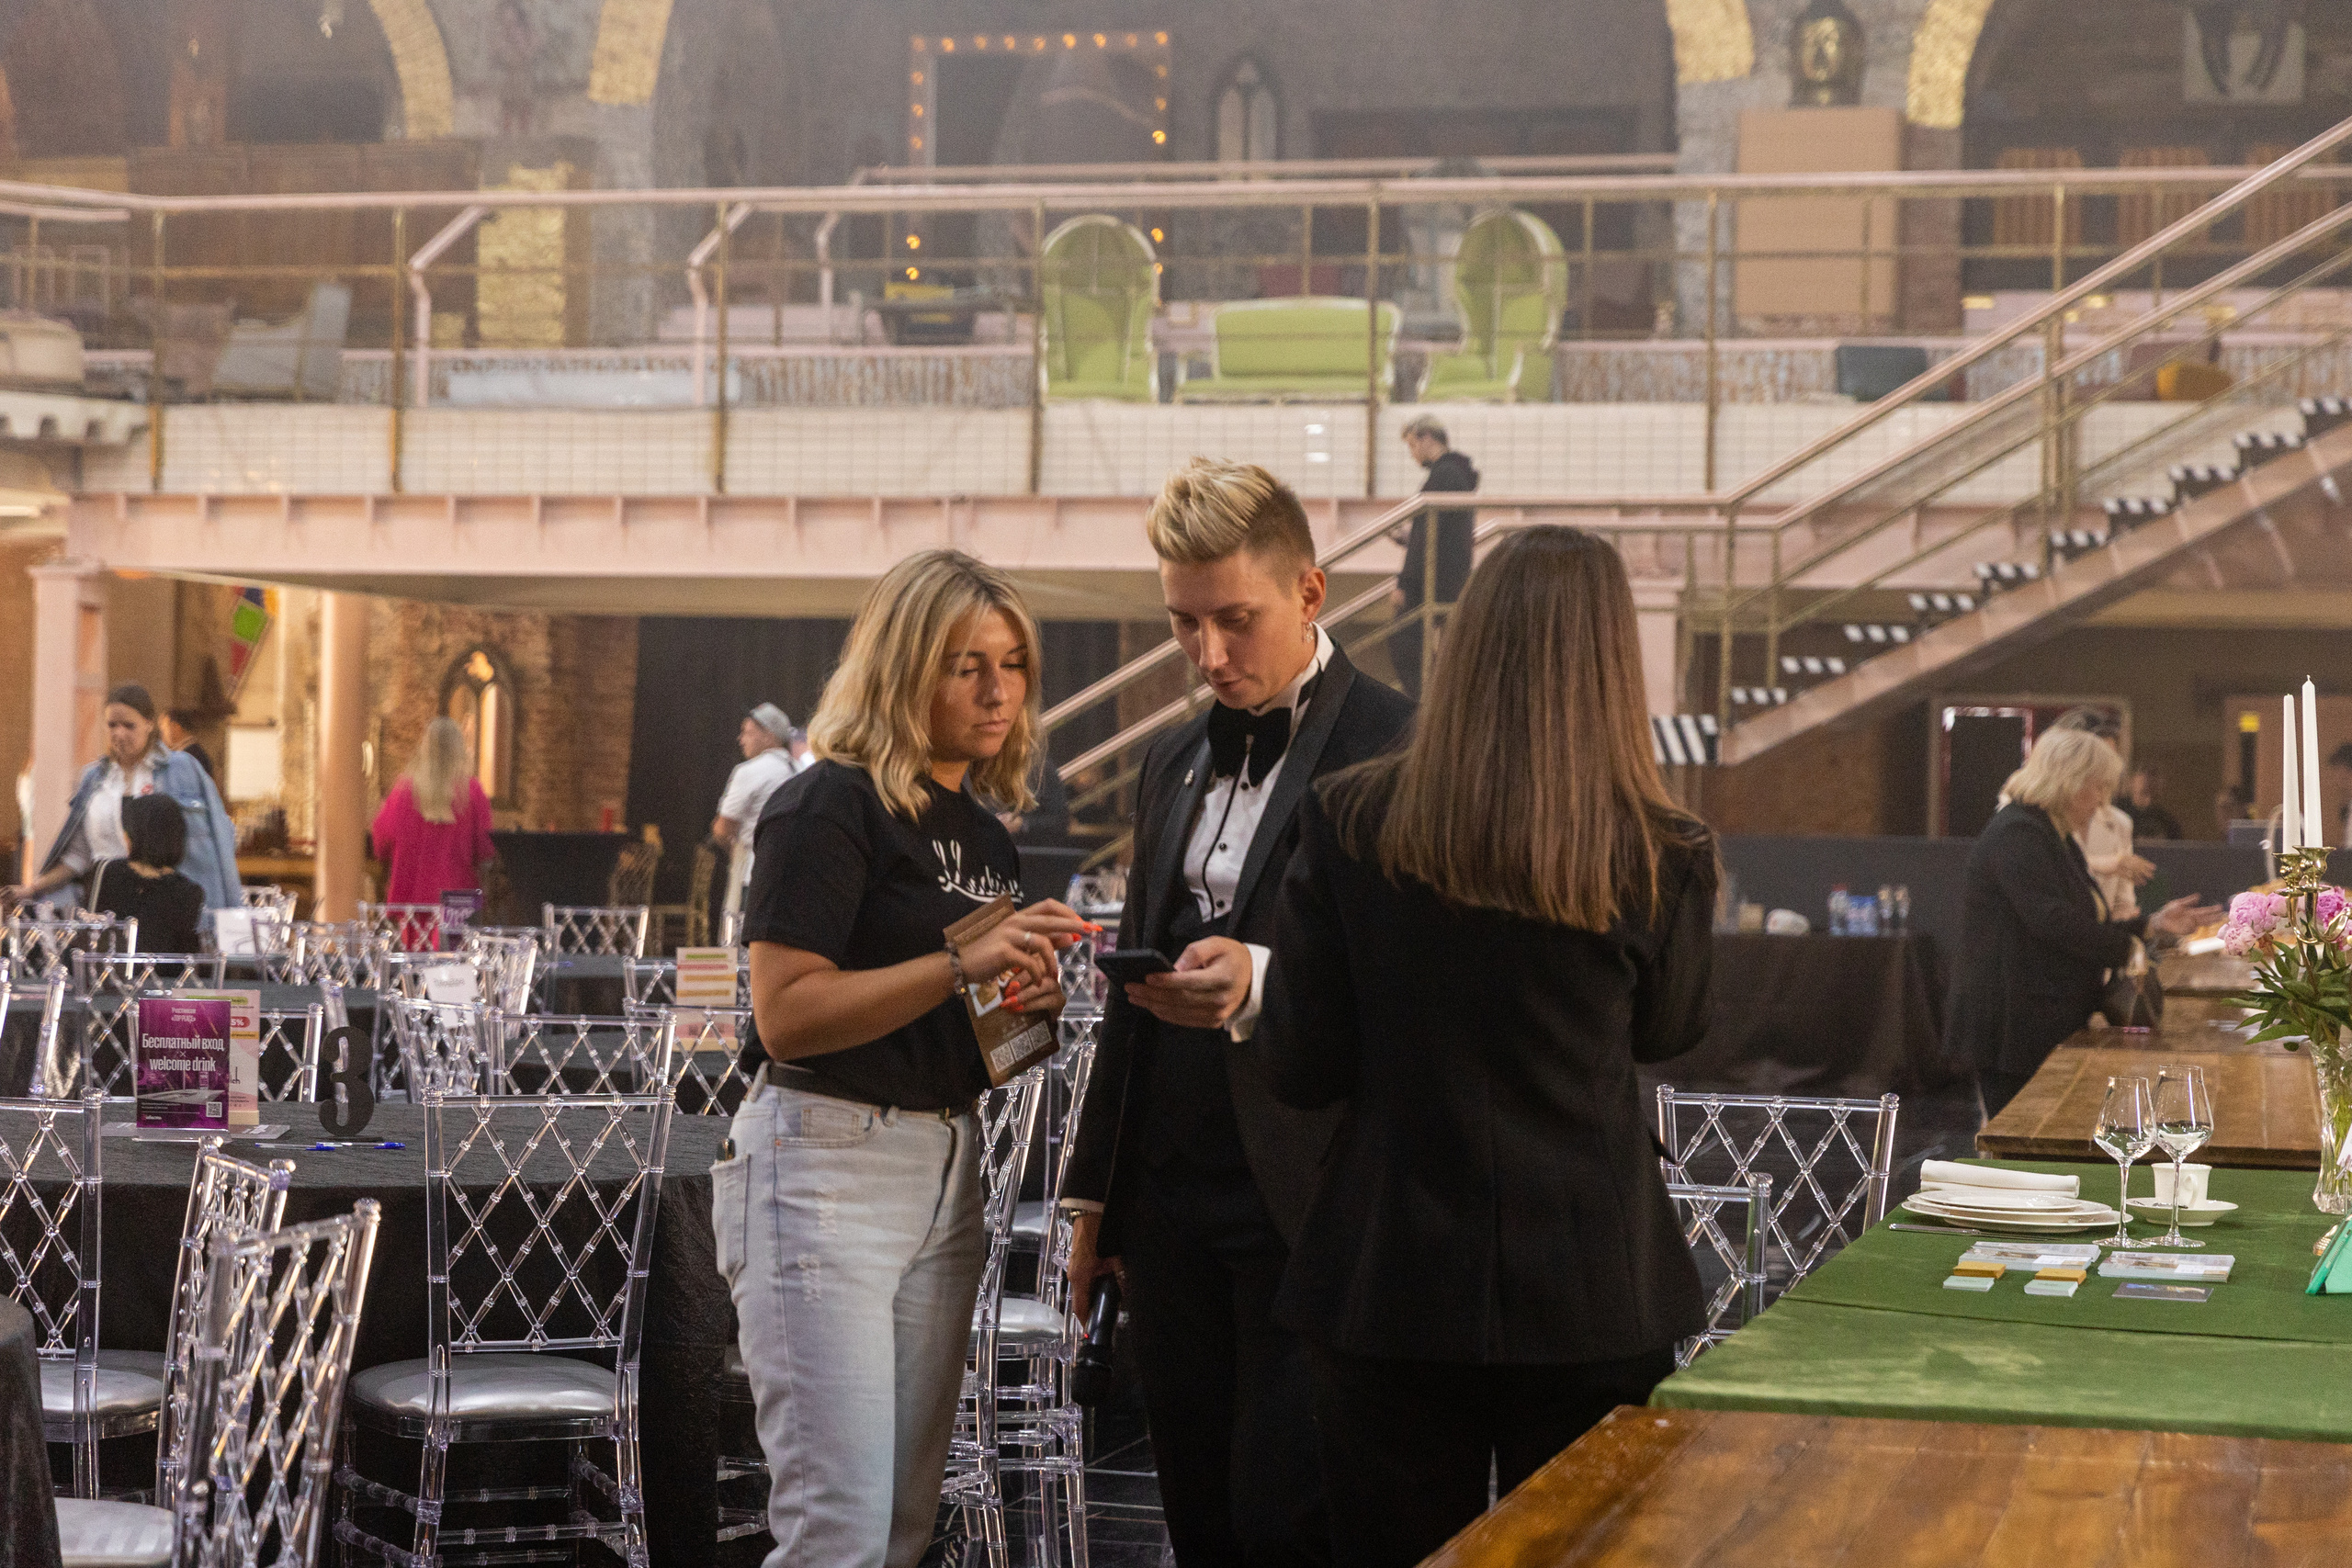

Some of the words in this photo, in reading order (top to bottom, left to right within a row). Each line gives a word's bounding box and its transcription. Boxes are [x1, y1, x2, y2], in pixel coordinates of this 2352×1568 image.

[141, 1033, 201, 1050] Бесплатный
[202, 1038, 225, 1052] вход
[149, 1055, 191, 1071] welcome
[192, 1056, 216, 1072] drink
[318, 1026, 375, 1137] 3
